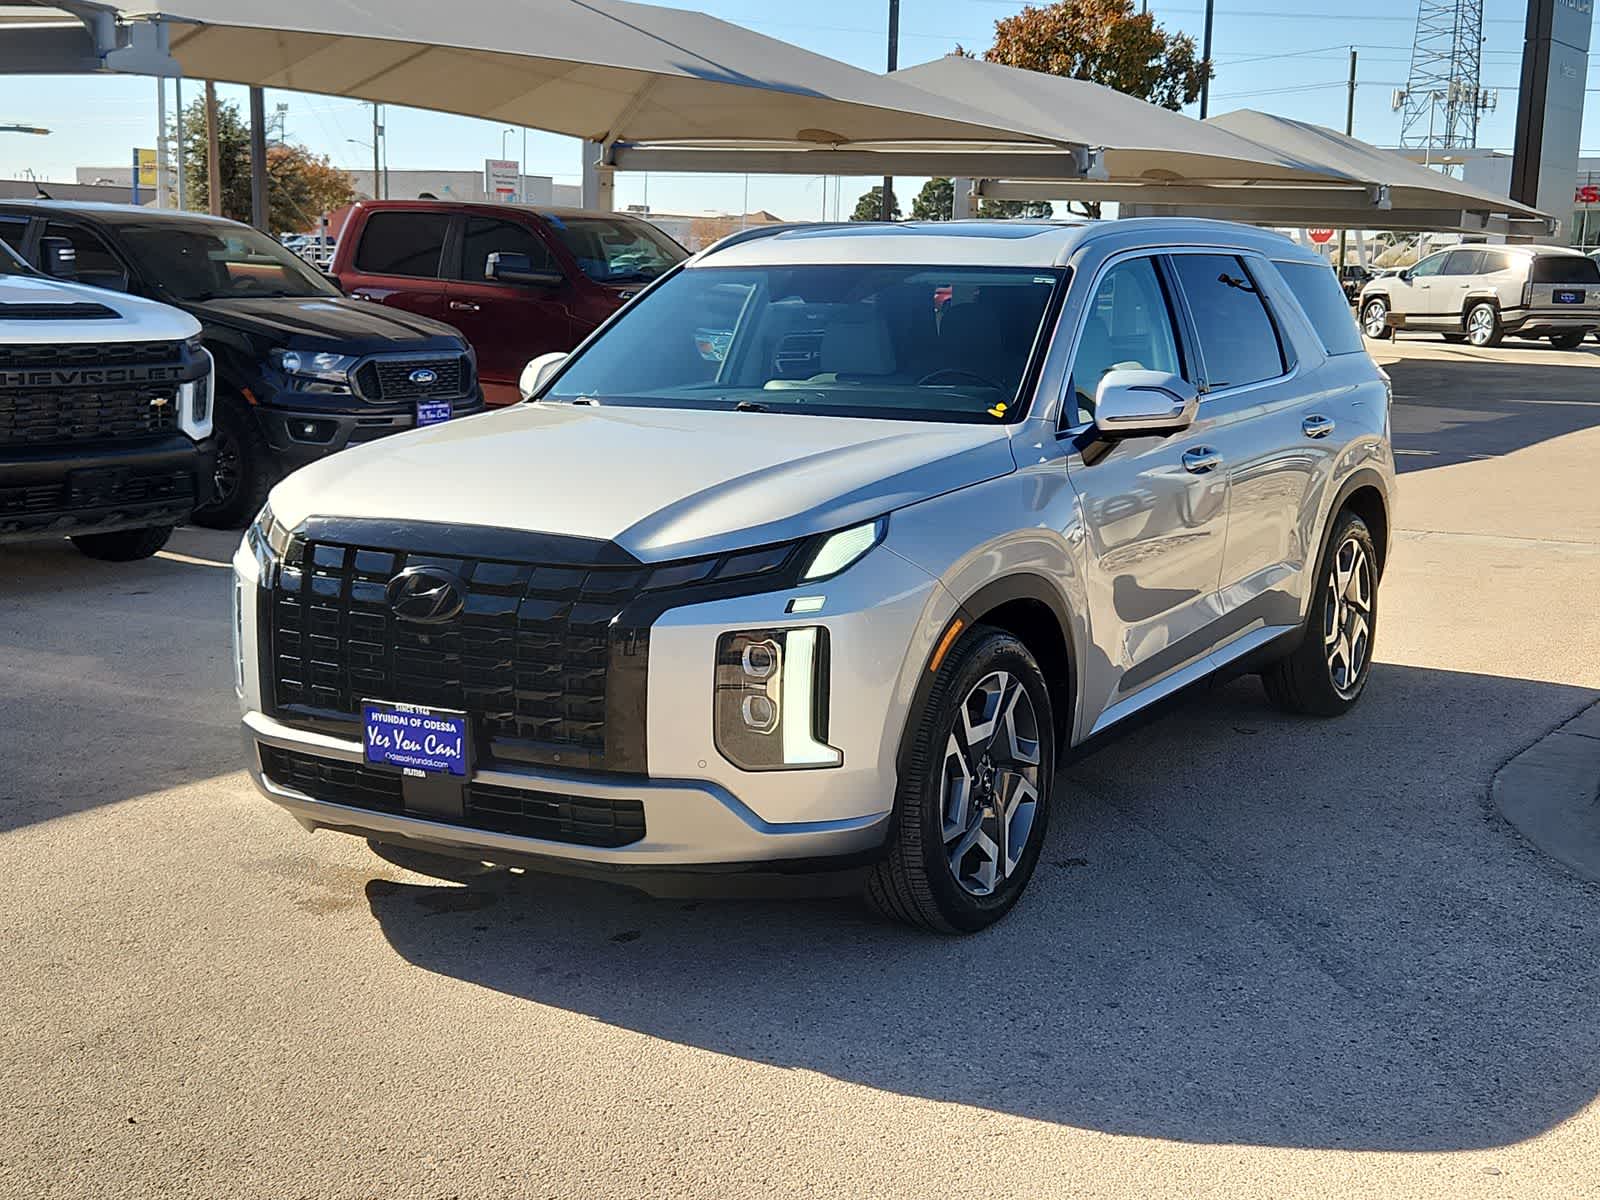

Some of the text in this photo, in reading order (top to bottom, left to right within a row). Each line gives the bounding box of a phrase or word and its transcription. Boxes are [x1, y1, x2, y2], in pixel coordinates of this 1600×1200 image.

[0, 366, 185, 386] HEVROLET
[371, 712, 457, 733] HYUNDAI OF ODESSA
[367, 725, 462, 760] Yes You Can!
[385, 752, 448, 768] OdessaHyundai.com
